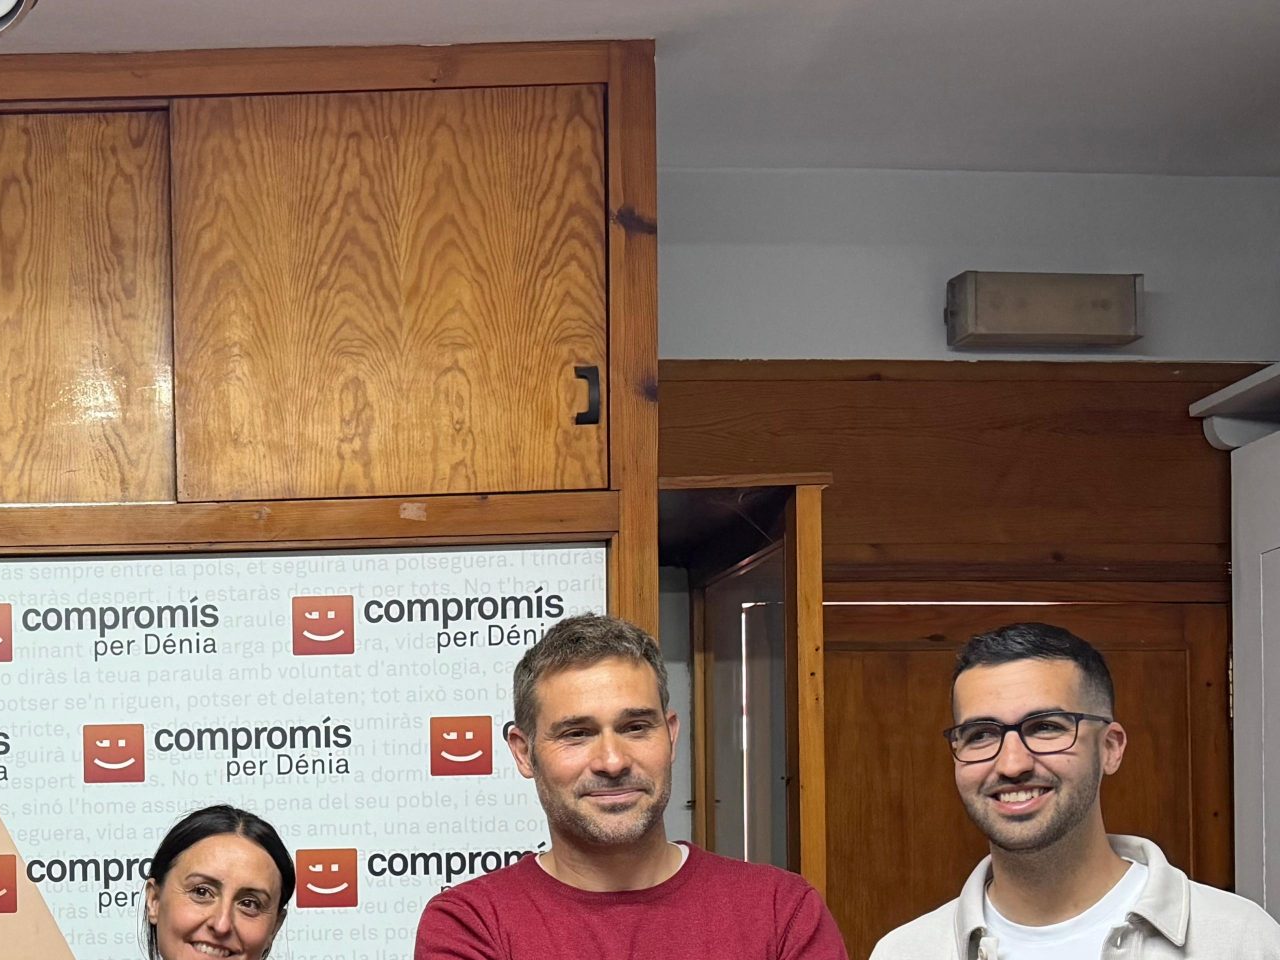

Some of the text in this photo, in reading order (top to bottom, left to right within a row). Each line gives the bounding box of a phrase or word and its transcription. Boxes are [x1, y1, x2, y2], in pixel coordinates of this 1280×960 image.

[23, 597, 218, 637] compromís
[364, 587, 564, 629] compromís
[95, 634, 216, 661] per Dénia
[437, 623, 545, 653] per Déni
[155, 717, 351, 758] compromís
[227, 754, 349, 782] per Dénia
[26, 858, 153, 889] compro
[98, 891, 139, 913] per
